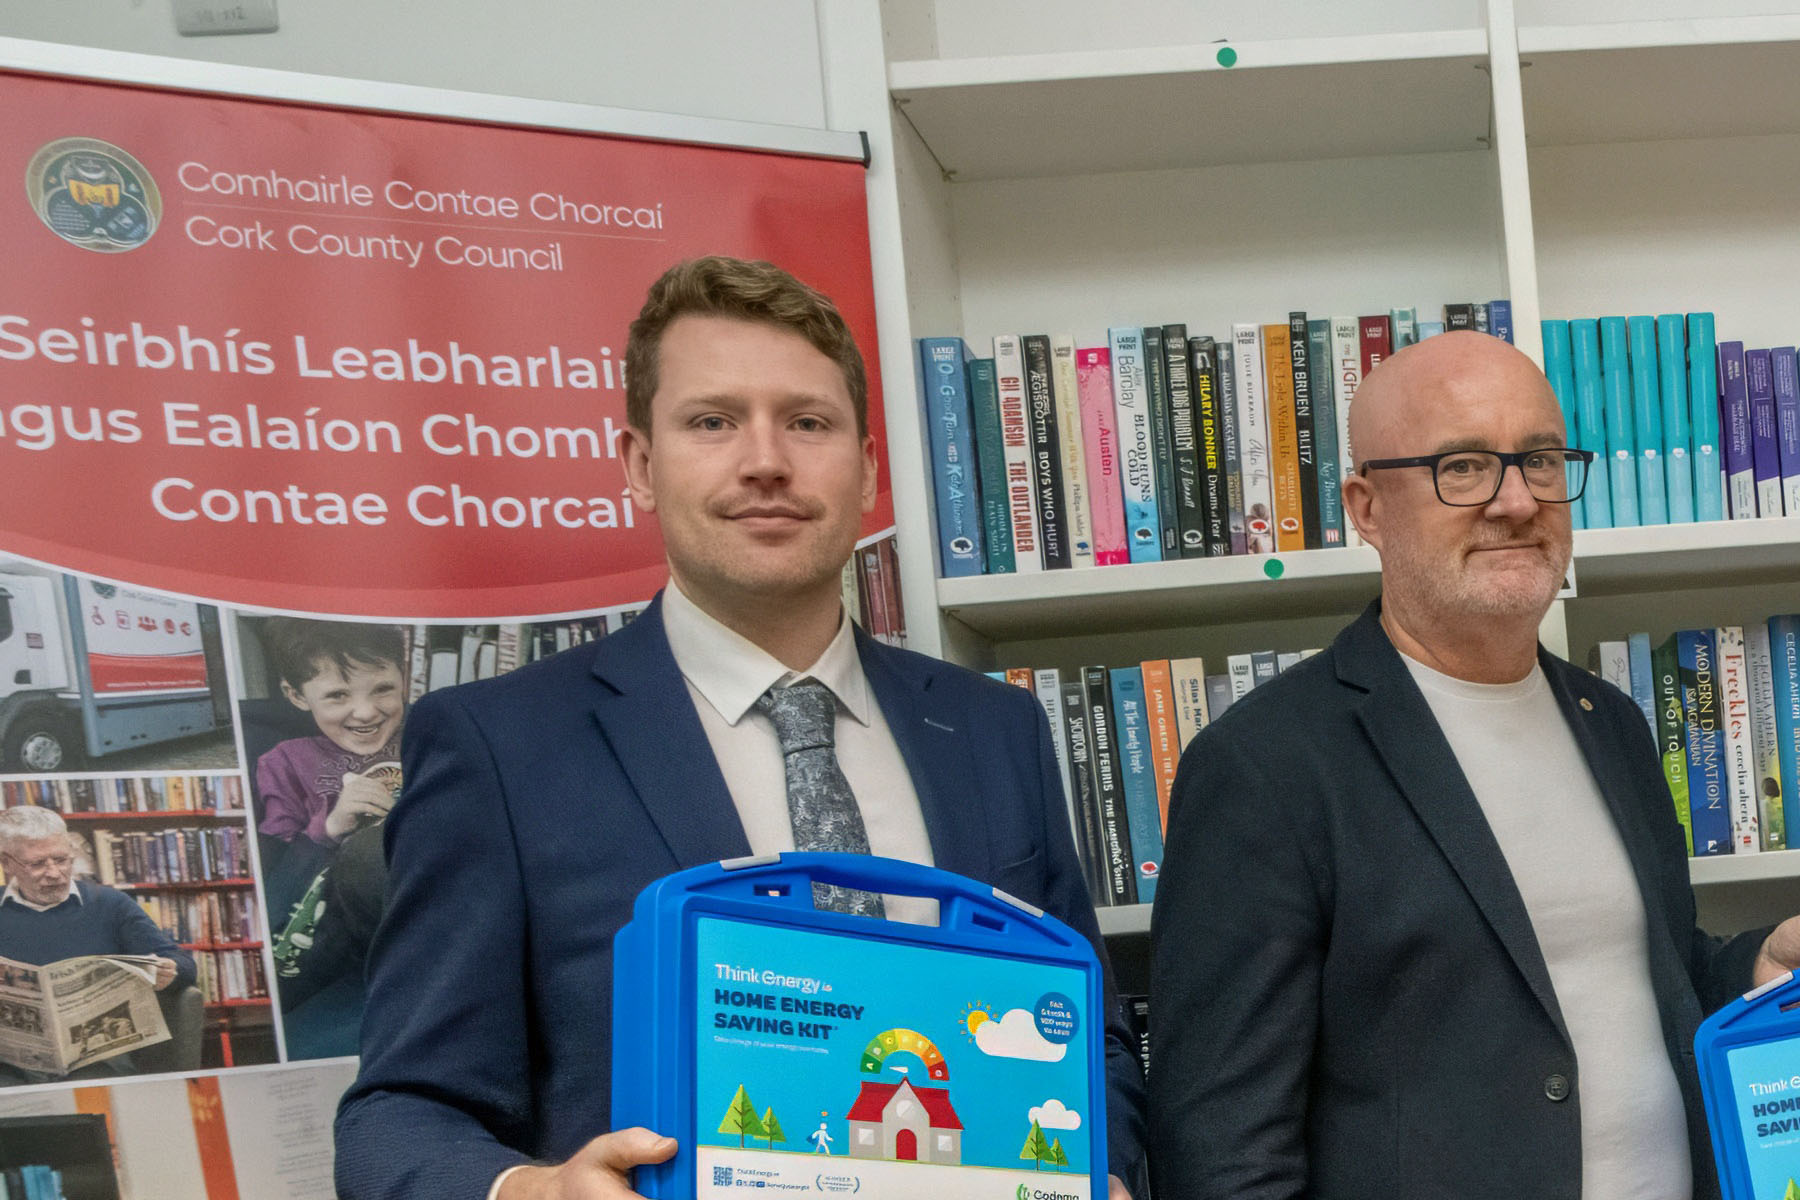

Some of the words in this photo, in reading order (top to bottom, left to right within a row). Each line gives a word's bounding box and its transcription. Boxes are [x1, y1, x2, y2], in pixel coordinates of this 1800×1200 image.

[178, 161, 374, 208] Comhairle
[384, 182, 520, 220] Contae
[530, 191, 665, 231] Chorcaí
[185, 215, 278, 253] Cork
[288, 224, 424, 268] County
[435, 236, 565, 273] Council
[0, 314, 275, 375] Seirbhís
[1292, 341, 1305, 367] KEN
[1118, 355, 1135, 409] Barclay
[1199, 375, 1212, 417] HILARY
[1295, 372, 1309, 416] BRUEN
[0, 403, 141, 449] gus
[163, 401, 402, 454] Ealaíon
[1001, 395, 1026, 447] ADAMSON
[1134, 414, 1148, 461] BLOOD
[1173, 409, 1194, 451] PROBLEM
[1100, 426, 1111, 476] Austen
[1203, 419, 1216, 470] BONNER
[1299, 430, 1312, 465] BLITZ
[1008, 460, 1027, 486] THE
[1040, 451, 1050, 486] BOYS
[1127, 450, 1140, 486] COLD
[1138, 461, 1151, 502] RUNS
[152, 477, 388, 527] Contae
[406, 481, 635, 530] Chorcaí
[1010, 486, 1034, 553] OUTLANDER
[1041, 486, 1054, 520] WHO
[1045, 522, 1059, 558] HURT
[1664, 675, 1673, 702] OUT
[1695, 644, 1714, 715] MODERN
[1725, 654, 1746, 740] Freckles
[1093, 706, 1108, 750] GORDON
[1666, 709, 1675, 728] OF
[1100, 753, 1113, 792] FERRIS
[1667, 735, 1681, 783] TOUCH
[1700, 719, 1721, 810] DIVINATION
[714, 988, 777, 1010] HOME
[780, 993, 864, 1021] ENERGY
[714, 1012, 794, 1036] SAVING
[798, 1022, 833, 1040] KIT
